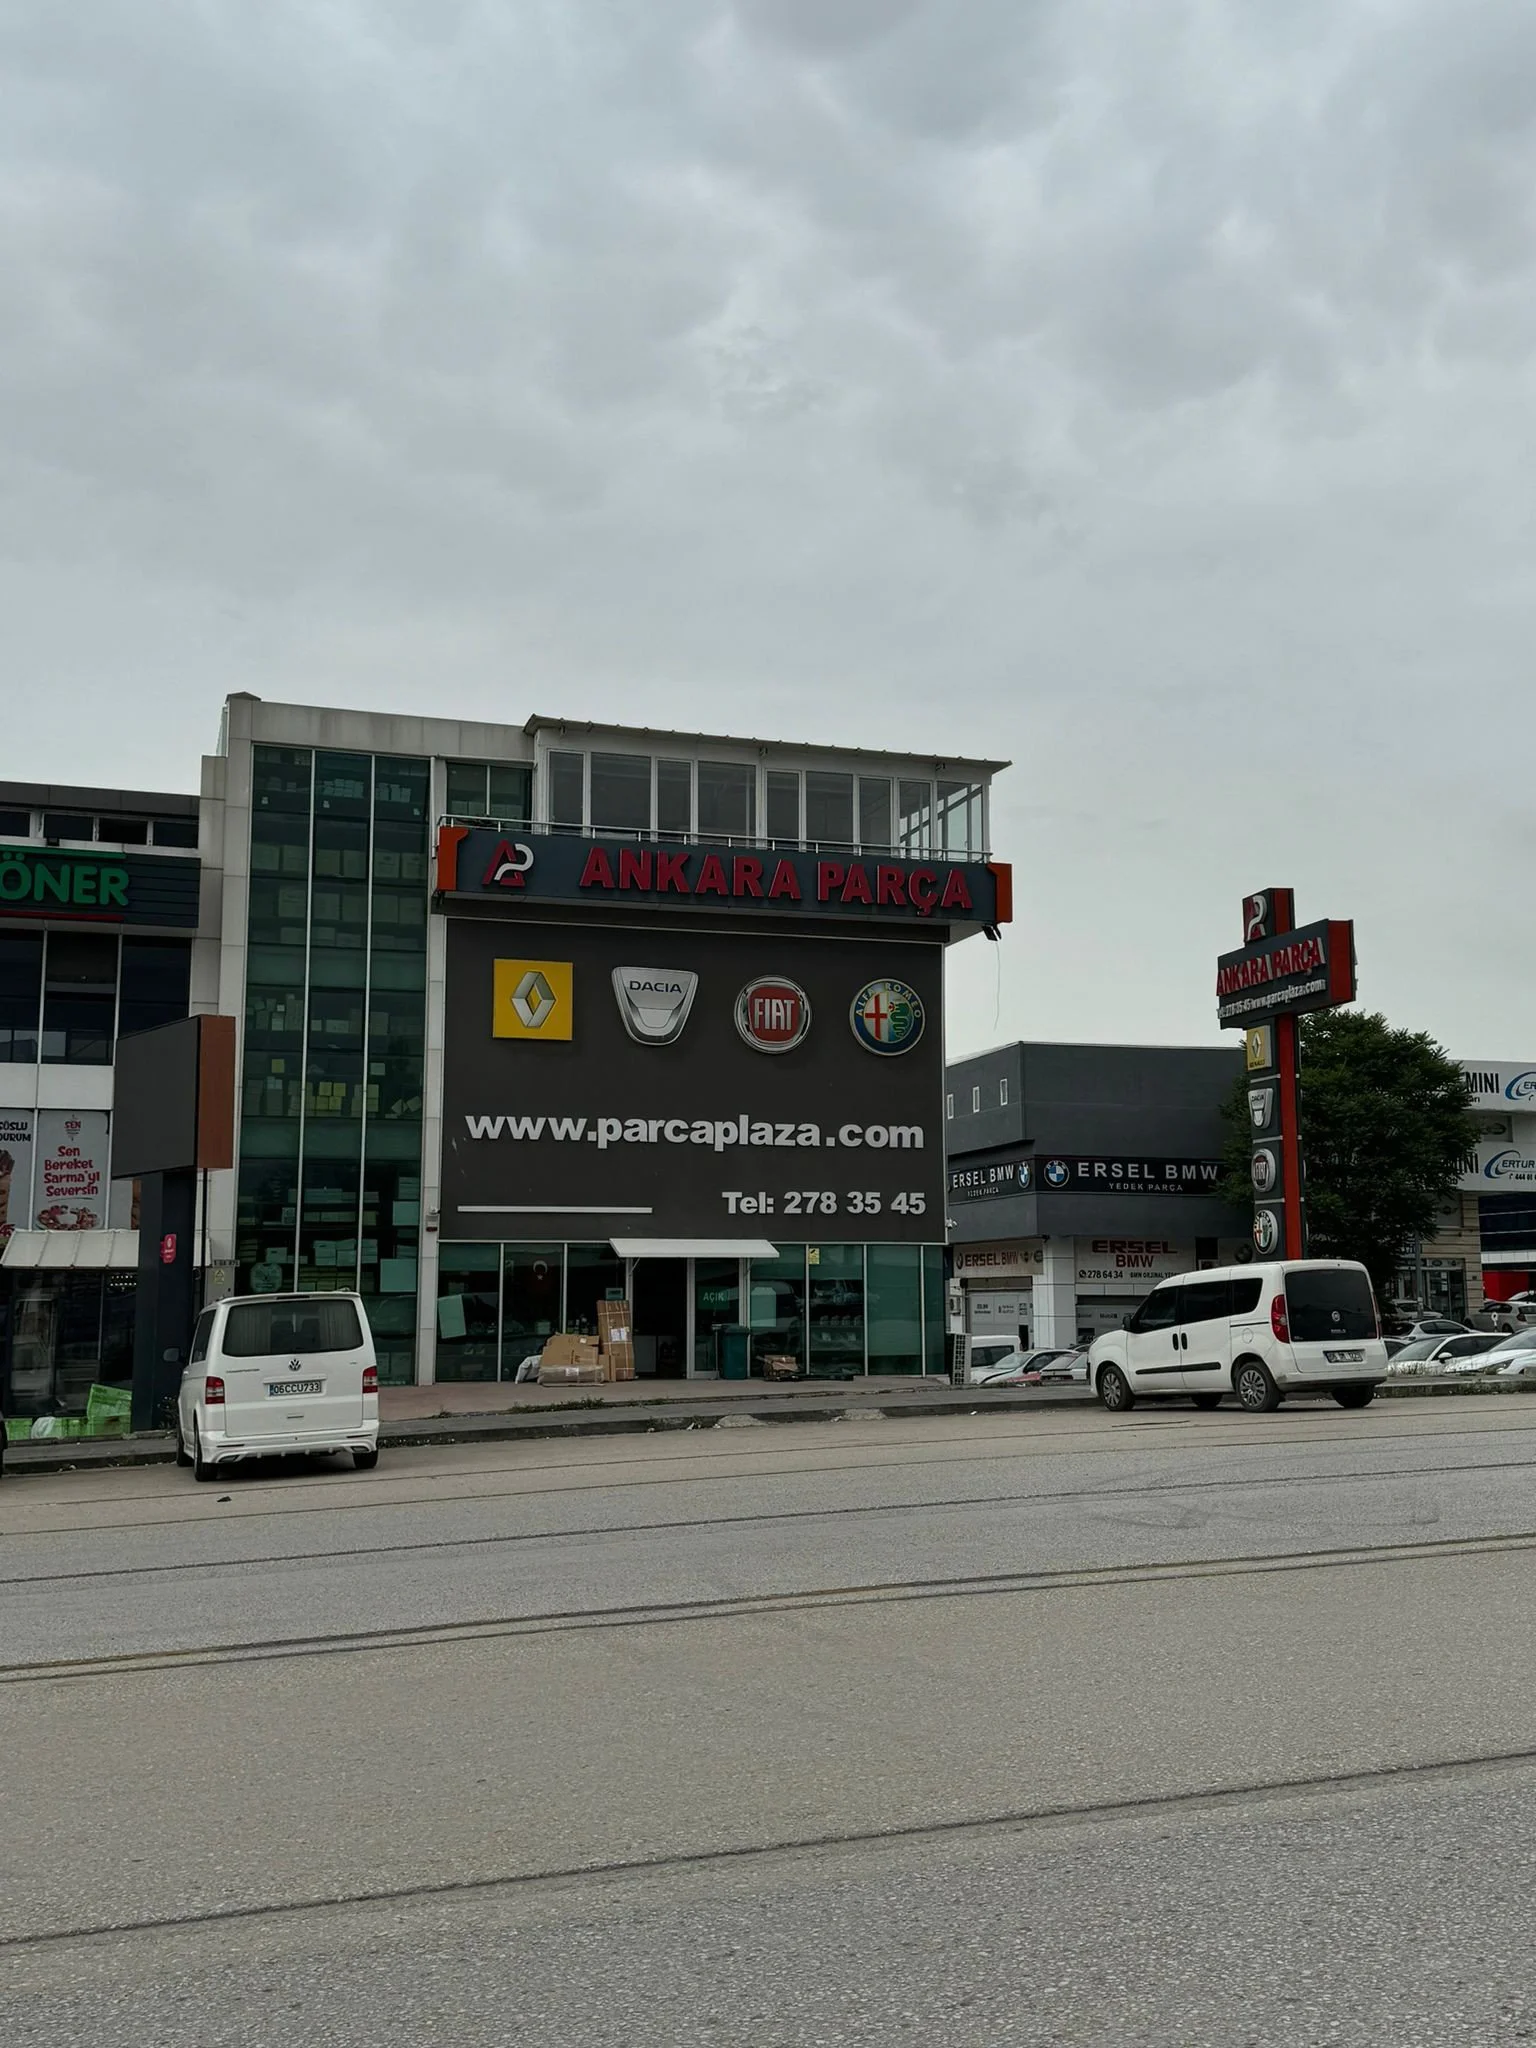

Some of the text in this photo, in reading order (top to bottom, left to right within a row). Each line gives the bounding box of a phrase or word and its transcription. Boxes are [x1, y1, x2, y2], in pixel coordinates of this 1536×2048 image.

[579, 848, 973, 916] ANKARA PARÇA
[1216, 937, 1326, 996] ANKARA PARÇA
[629, 980, 682, 993] DACIA
[856, 982, 922, 1018] ALFA ROMEO
[754, 998, 795, 1031] FIAT
[1465, 1071, 1500, 1094] MINI
[465, 1114, 925, 1152] www.parcaplaza.com
[58, 1146, 80, 1157] Sen
[45, 1159, 93, 1171] Bereket
[1077, 1162, 1218, 1180] ERSEL BMW
[1502, 1160, 1535, 1169] ERTUR
[953, 1164, 1014, 1188] ERSEL BMW
[46, 1184, 98, 1197] Seversin
[1109, 1182, 1183, 1192] YEDEK PARÇA
[722, 1191, 926, 1216] Tel: 278 35 45
[1092, 1240, 1178, 1254] ERSEL
[965, 1252, 1000, 1267] ERSEL
[1116, 1255, 1154, 1268] BMW
[1087, 1270, 1123, 1279] 278 64 34
